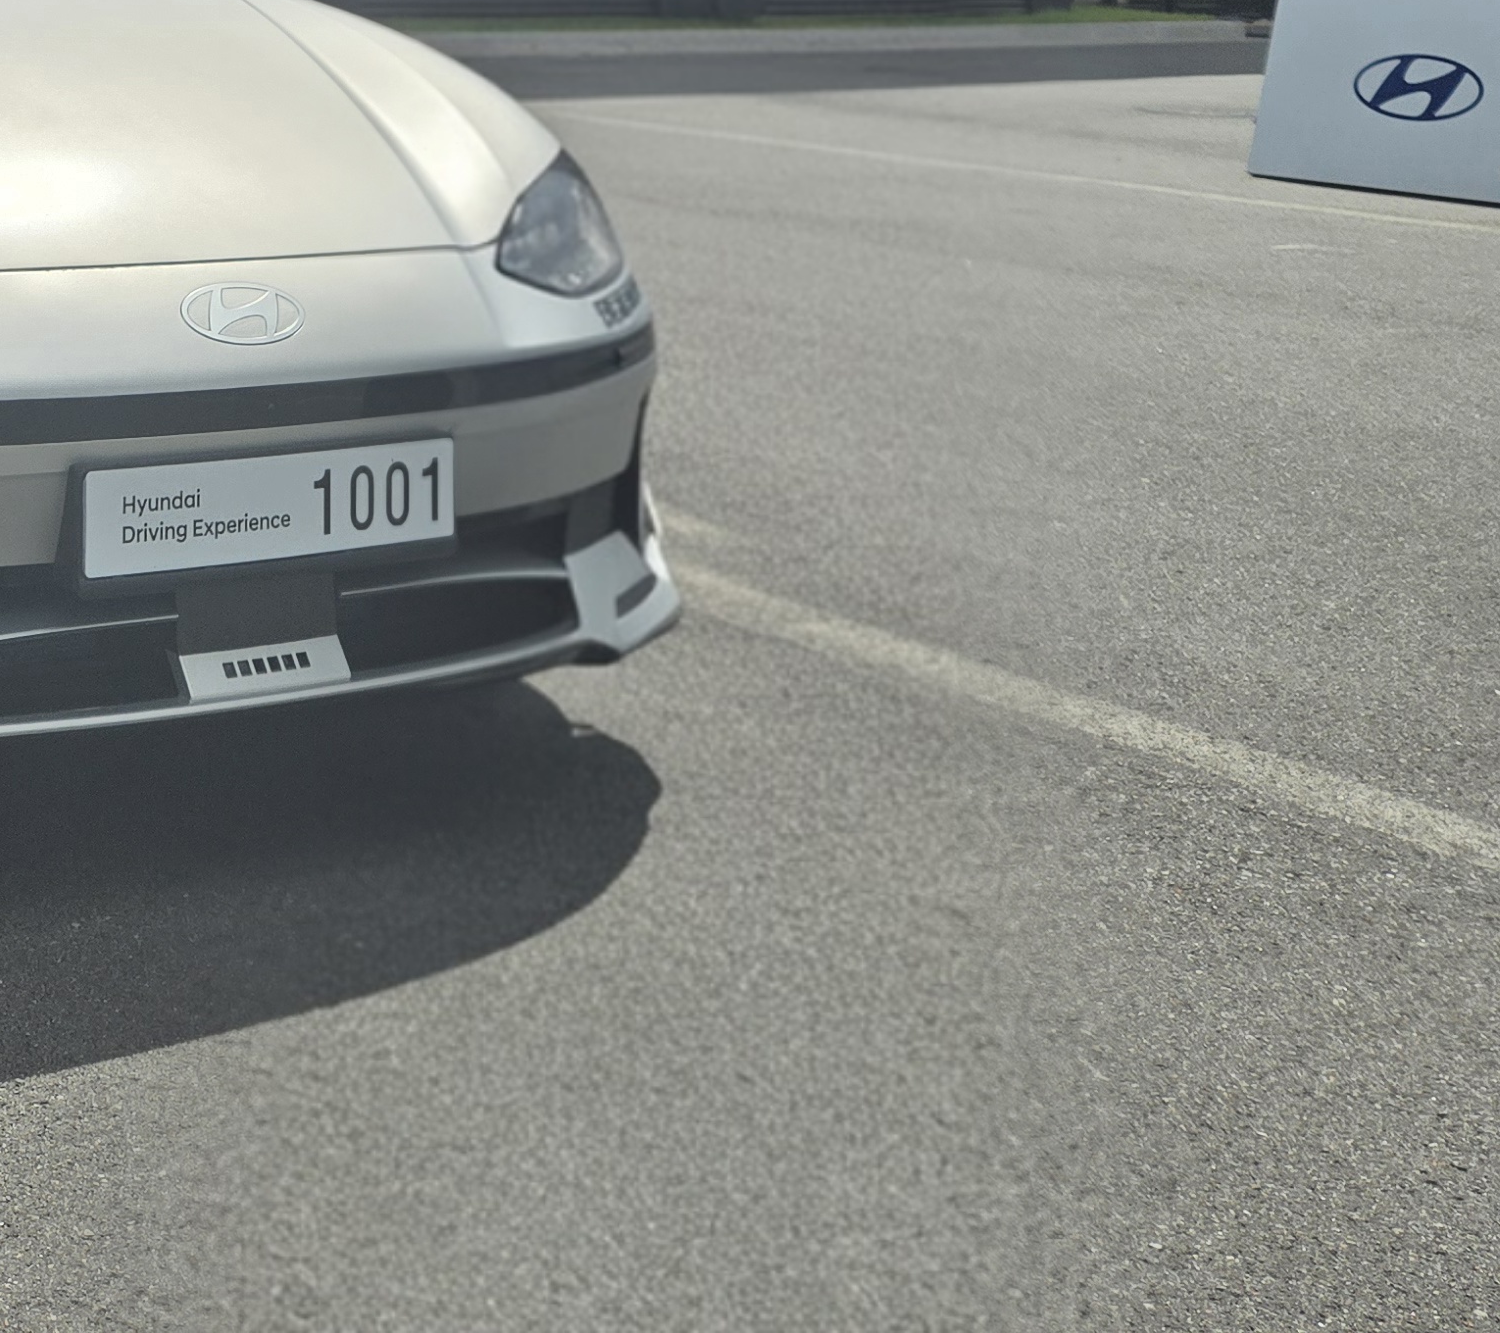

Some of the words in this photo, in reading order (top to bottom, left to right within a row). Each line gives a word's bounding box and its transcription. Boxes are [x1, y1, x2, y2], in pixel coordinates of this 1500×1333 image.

[122, 489, 200, 516] Hyundai
[313, 457, 438, 535] 1001
[122, 521, 187, 544] Driving
[193, 513, 291, 539] Experience
